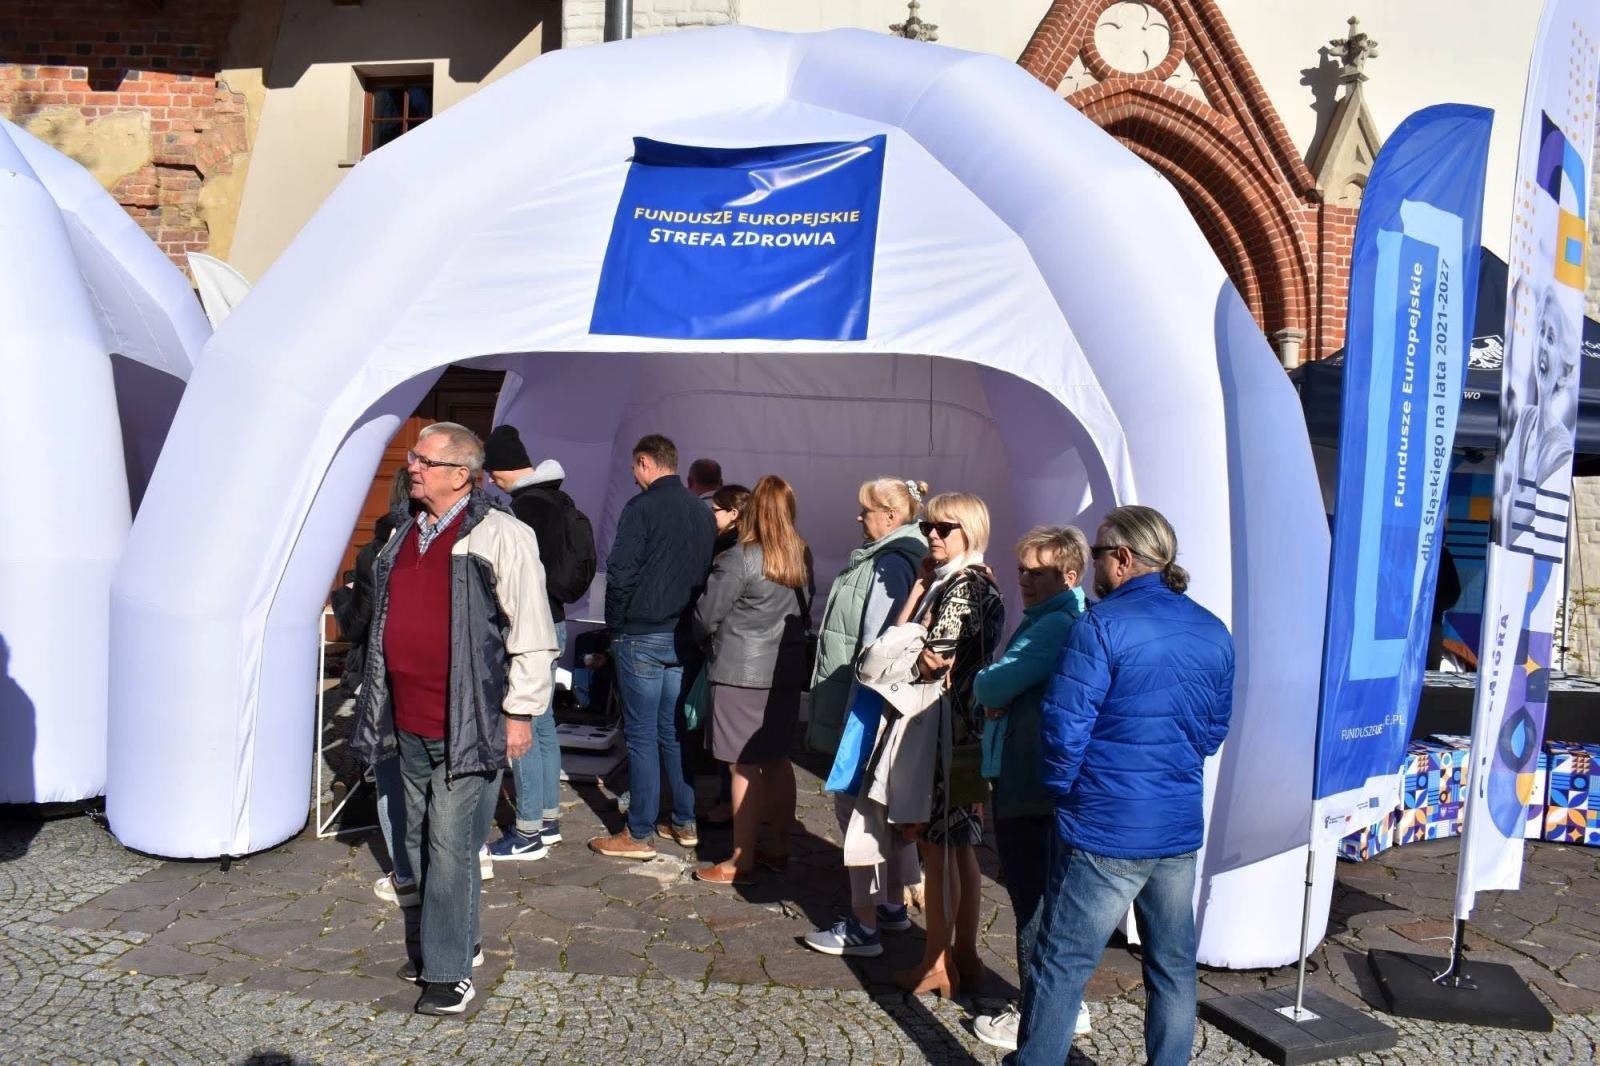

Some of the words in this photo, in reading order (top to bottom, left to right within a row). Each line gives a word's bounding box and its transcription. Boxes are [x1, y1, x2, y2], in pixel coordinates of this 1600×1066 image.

[633, 207, 732, 225] FUNDUSZE
[738, 210, 860, 227] EUROPEJSKIE
[648, 228, 726, 246] STREFA
[731, 231, 836, 247] ZDROWIA
[1435, 258, 1450, 355] 2021-2027
[1402, 261, 1423, 394] Europejskie
[1433, 361, 1447, 399] lata
[1434, 404, 1446, 428] na
[1394, 400, 1412, 508] Fundusze
[1423, 434, 1446, 526] Śląskiego
[1421, 533, 1434, 561] dla
